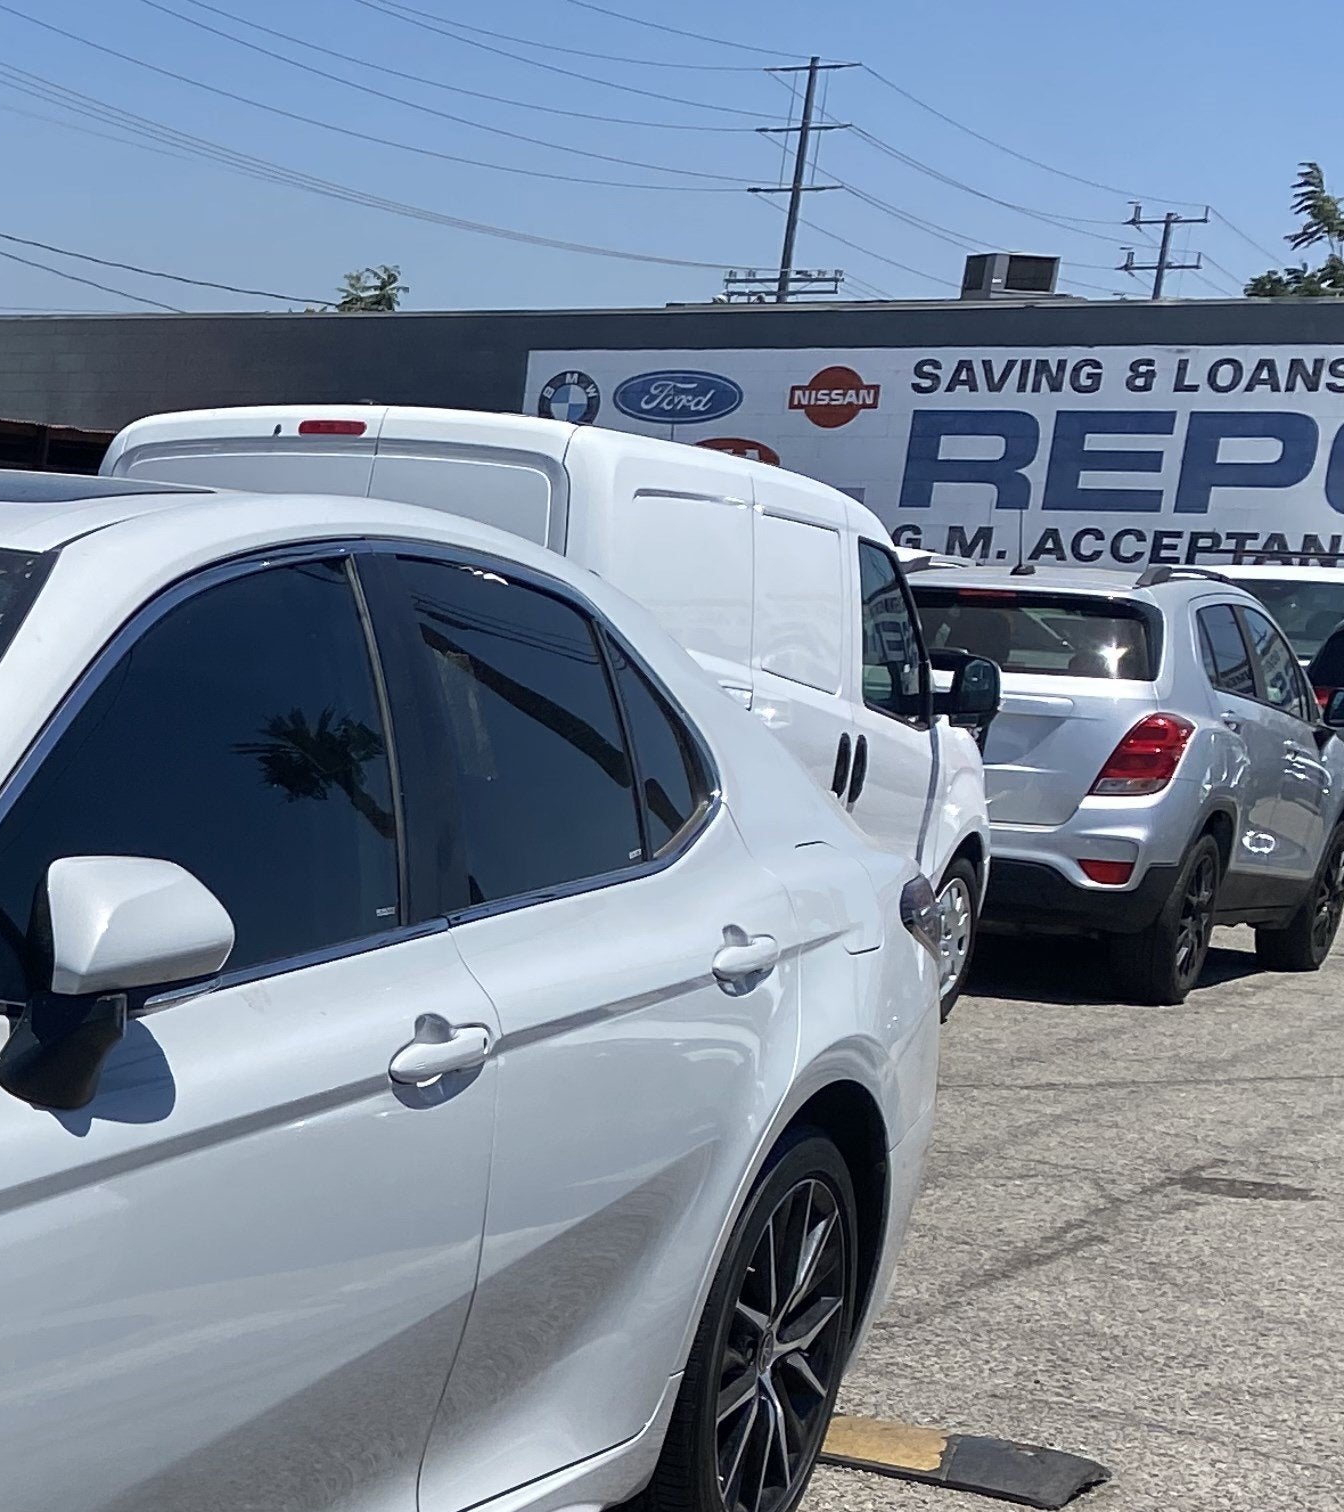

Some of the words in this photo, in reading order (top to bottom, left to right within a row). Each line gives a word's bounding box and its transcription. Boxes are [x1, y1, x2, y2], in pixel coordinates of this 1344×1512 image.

[542, 372, 598, 400] BMW
[910, 357, 1104, 394] SAVING
[1125, 357, 1157, 394] &
[640, 380, 716, 412] Ford
[793, 389, 875, 406] NISSAN
[899, 408, 1344, 515] REP
[892, 523, 1007, 560] GM.
